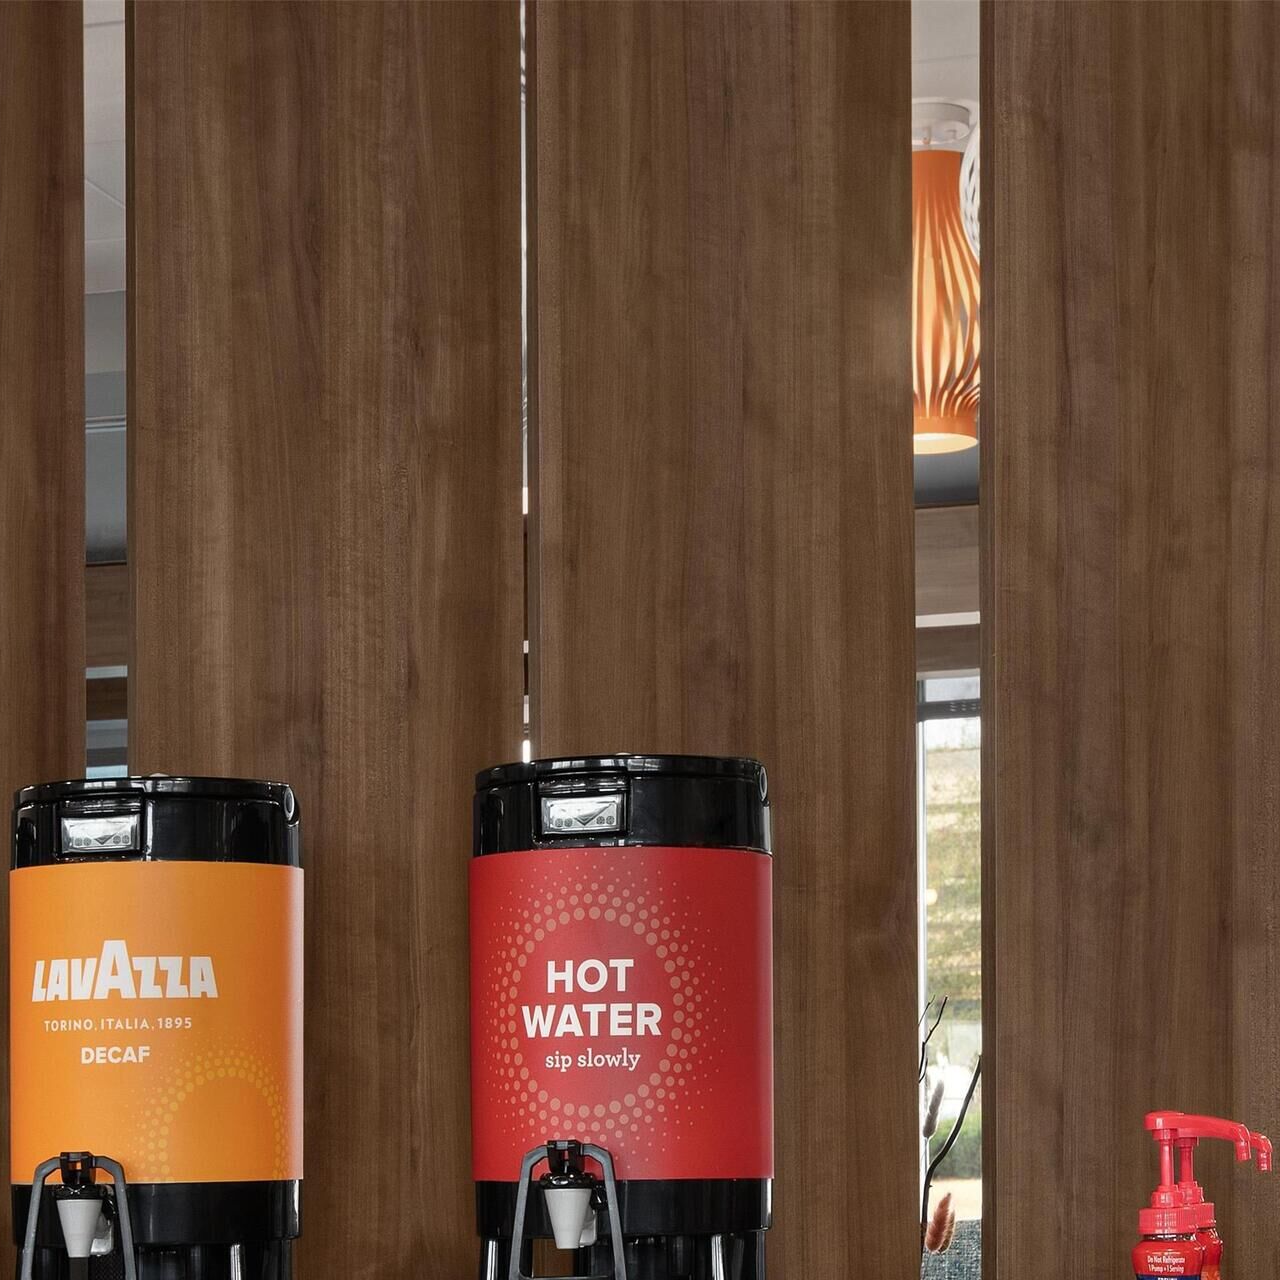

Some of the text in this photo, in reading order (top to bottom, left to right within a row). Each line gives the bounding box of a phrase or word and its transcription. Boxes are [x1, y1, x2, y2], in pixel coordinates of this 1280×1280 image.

[31, 939, 219, 1002] LAVAZZA
[546, 958, 635, 993] HOT
[157, 1016, 192, 1030] 1895
[521, 1002, 662, 1038] WATER
[80, 1045, 151, 1064] DECAF
[545, 1047, 641, 1072] sip slowly
[1147, 1255, 1154, 1264] Do
[1154, 1256, 1162, 1264] Not
